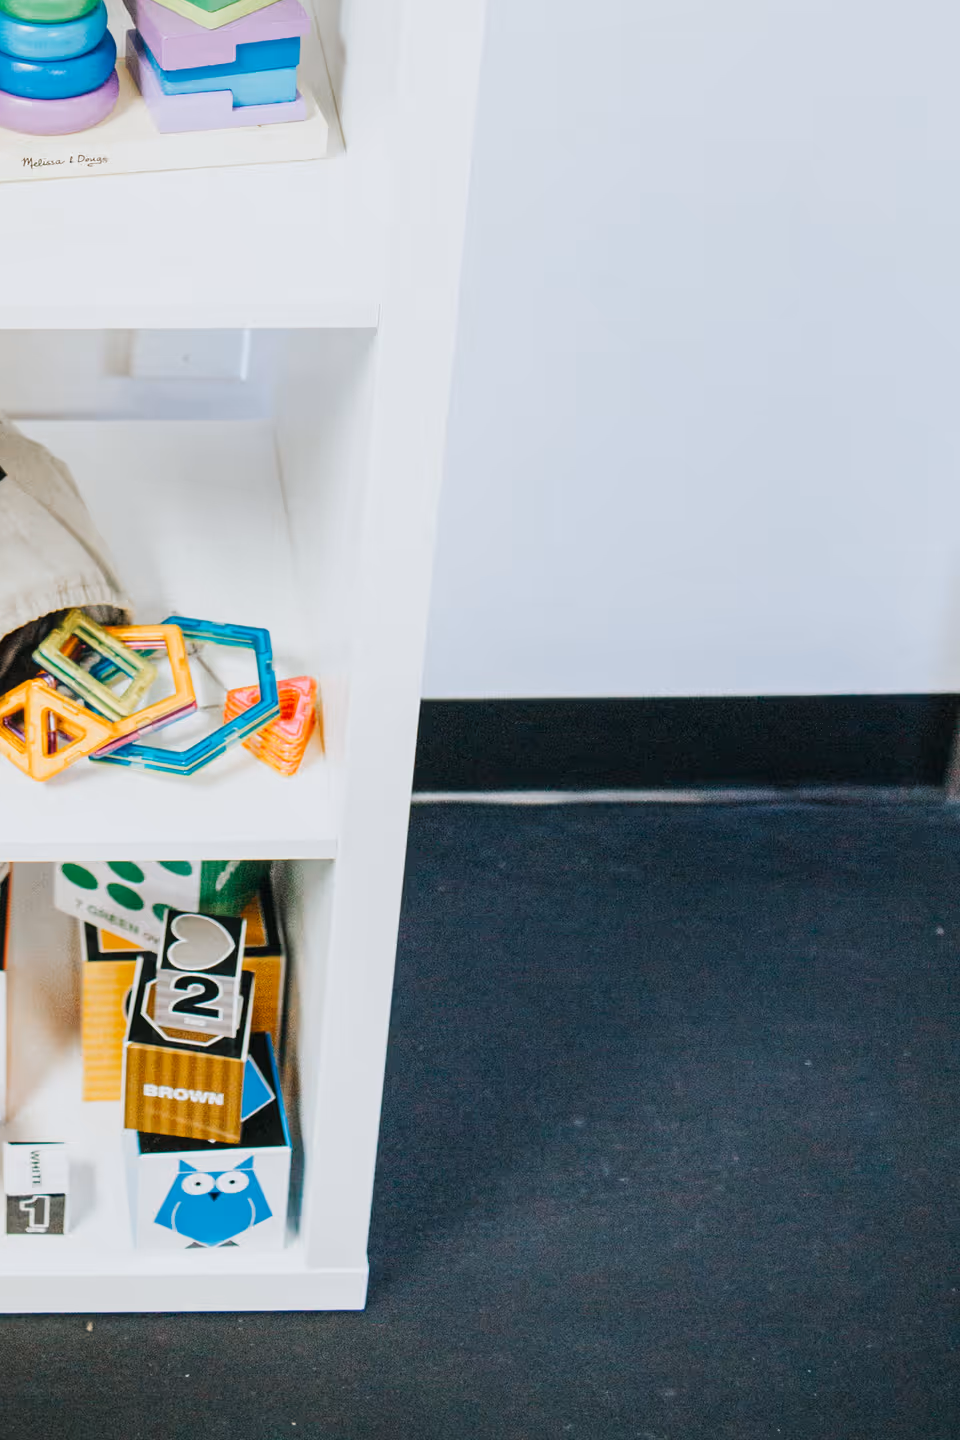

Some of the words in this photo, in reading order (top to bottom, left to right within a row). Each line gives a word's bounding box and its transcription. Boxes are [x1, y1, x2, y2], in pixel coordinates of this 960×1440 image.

[21, 157, 66, 169] Melissa
[169, 972, 223, 1021] 2
[142, 1083, 225, 1106] BROWN
[30, 1149, 42, 1188] WHITE
[19, 1194, 51, 1227] 1
